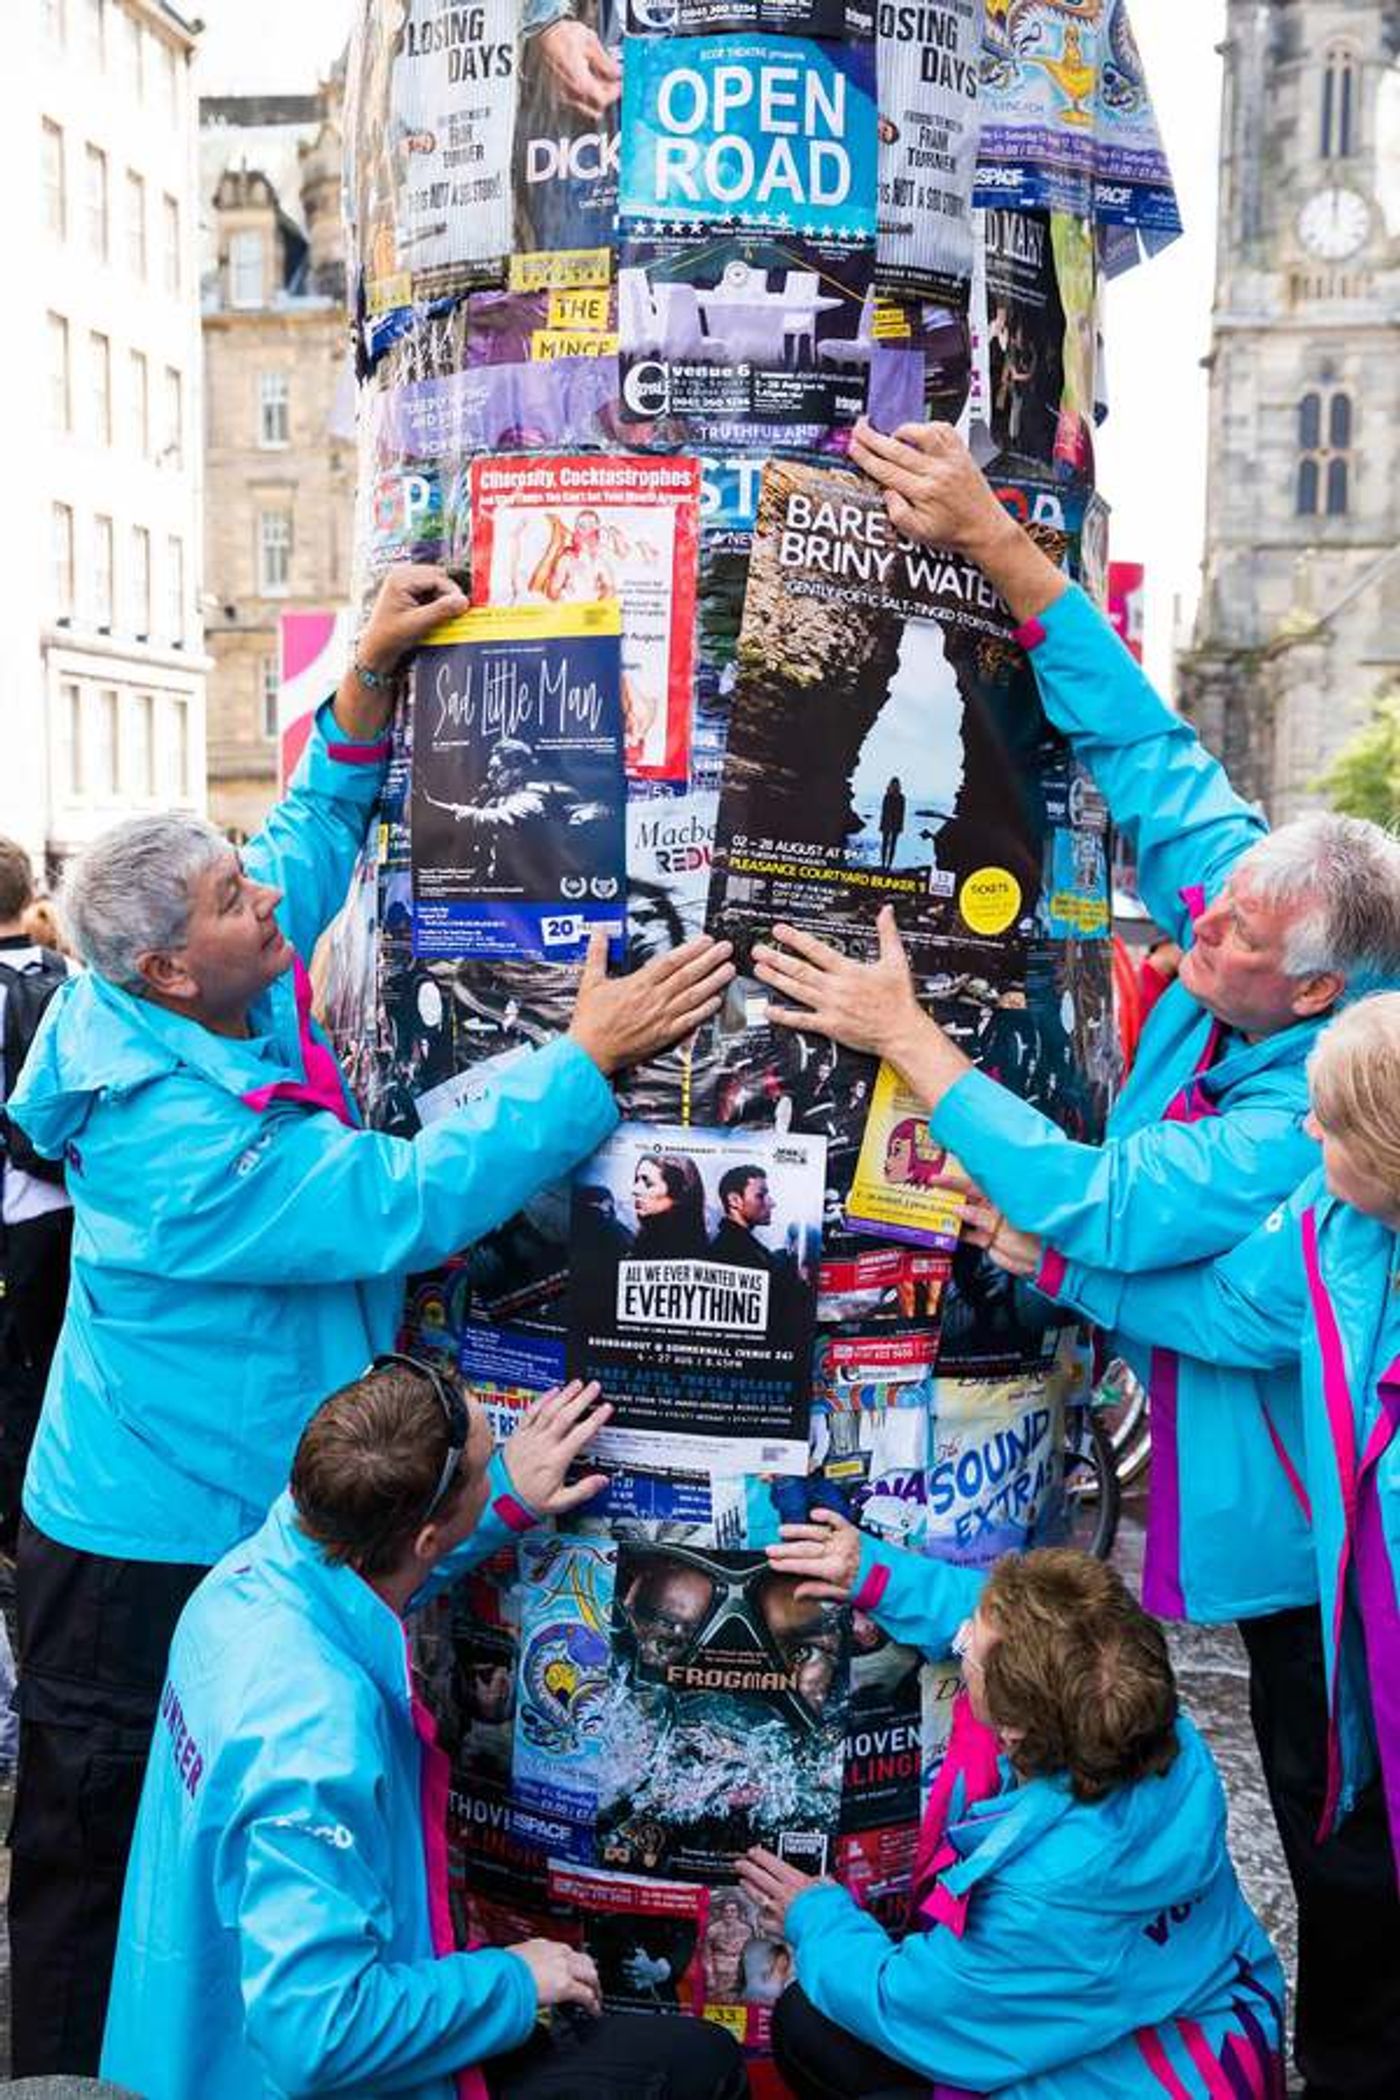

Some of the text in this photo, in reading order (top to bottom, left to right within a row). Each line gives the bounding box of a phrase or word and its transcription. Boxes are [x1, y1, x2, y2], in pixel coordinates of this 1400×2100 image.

[407, 9, 485, 57] LOSING
[448, 44, 513, 84] DAYS
[920, 47, 977, 98] DAYS
[657, 65, 846, 137] OPEN
[653, 134, 851, 206] ROAD
[893, 177, 916, 207] NOT
[557, 297, 600, 320] THE
[672, 363, 750, 378] venue 6
[786, 494, 887, 547] BARE
[779, 531, 896, 583] BRINY
[433, 658, 604, 741] Sad Little Man
[775, 839, 823, 857] AUGUST
[728, 857, 796, 878] PLEASANCE
[798, 864, 871, 886] COURTYARD
[547, 920, 574, 937] 20
[626, 1264, 763, 1291] ALL WE EVER WANTED WAS
[624, 1284, 761, 1325] EVERYTHING
[666, 1344, 731, 1358] SUMMERHALL
[929, 1408, 1051, 1515] SOUND
[666, 1665, 800, 1692] FROGMAN
[714, 2009, 737, 2023] 33
